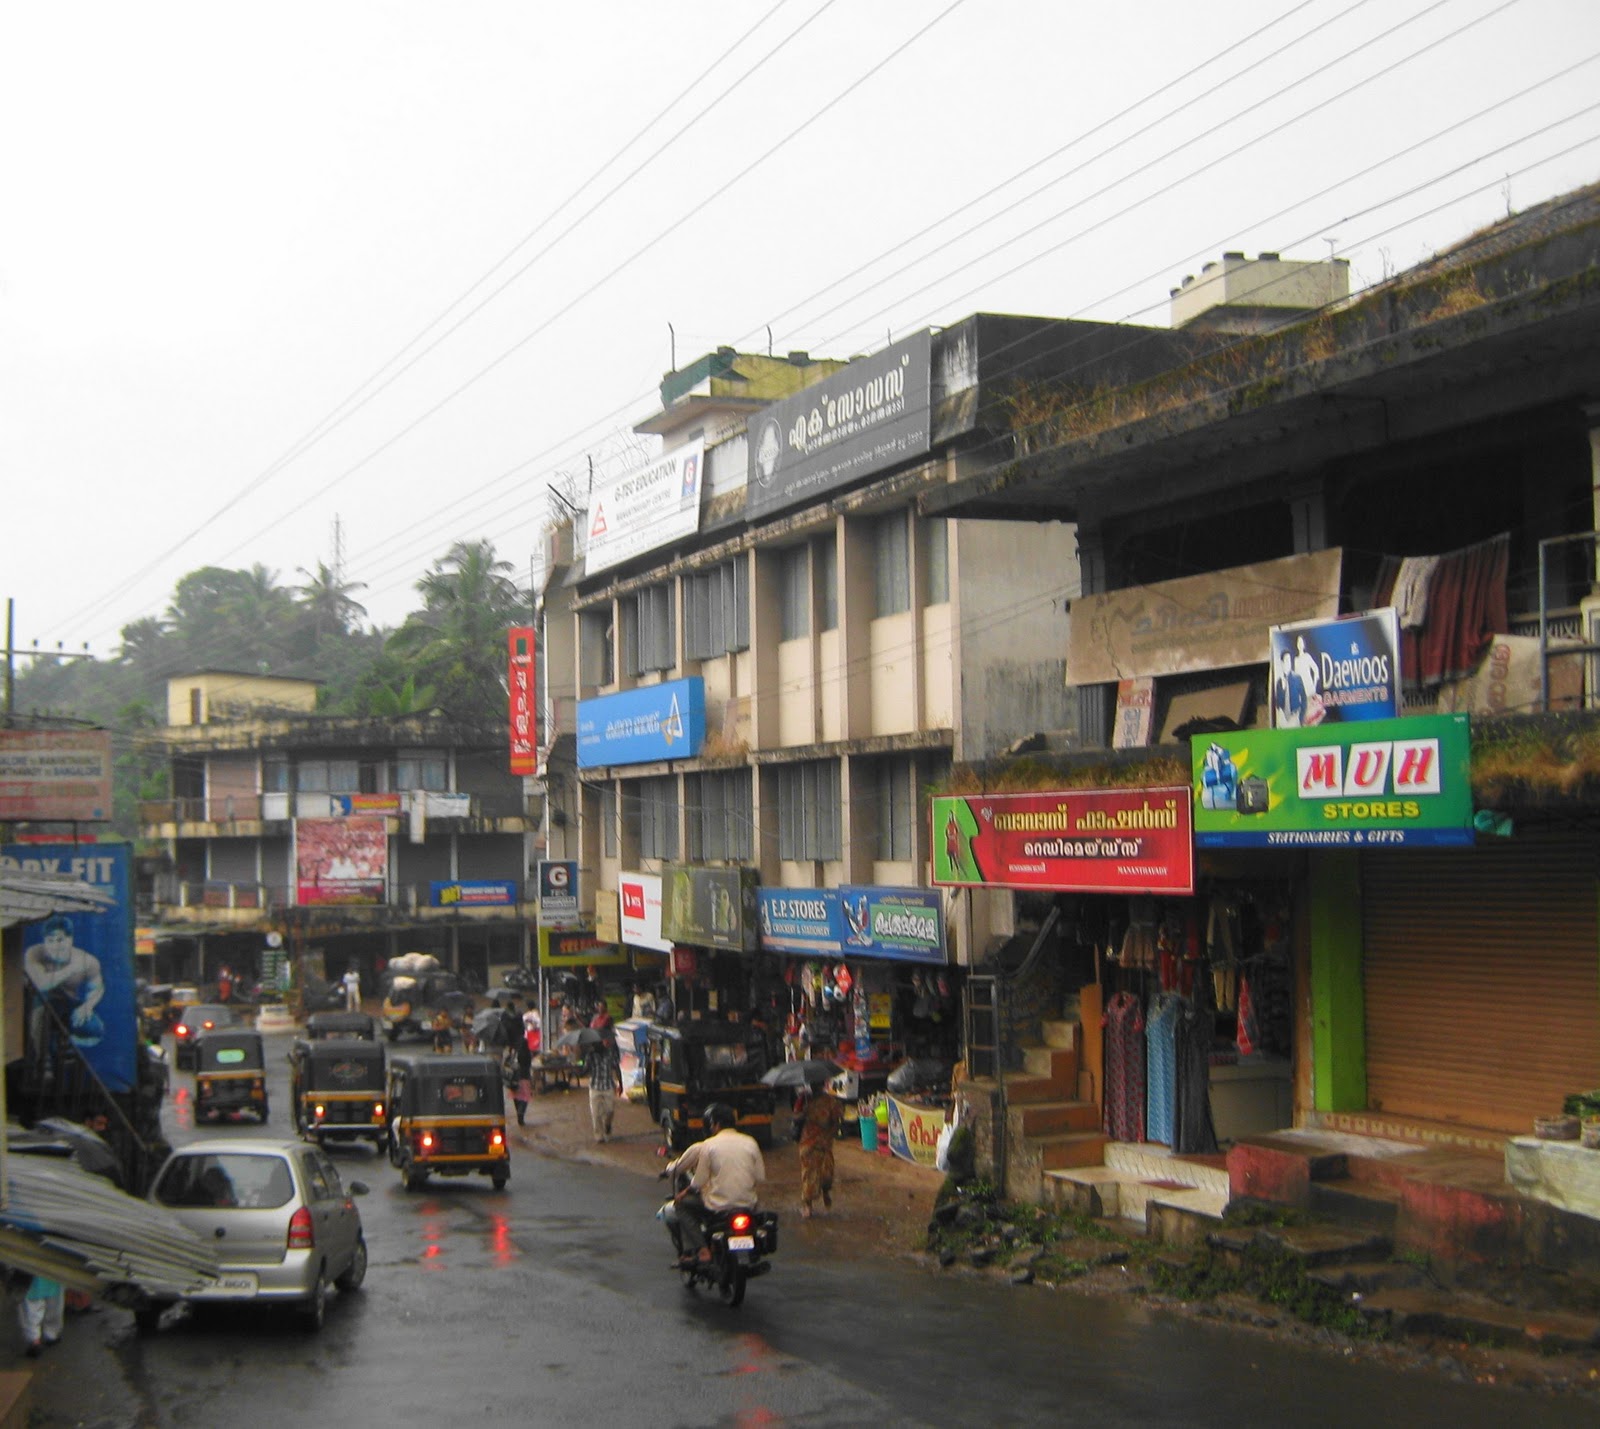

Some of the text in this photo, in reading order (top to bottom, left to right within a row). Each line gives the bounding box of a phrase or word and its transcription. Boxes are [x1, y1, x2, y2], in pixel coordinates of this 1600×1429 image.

[1321, 652, 1388, 690] Daewoos
[1323, 686, 1388, 706] GARMENTS
[1303, 747, 1432, 790] MUH
[994, 804, 1068, 832] ബാവാസ്
[1323, 801, 1420, 819] STORES
[1268, 830, 1405, 844] STATIONARIES & GIFTS
[71, 857, 115, 883] FIT
[549, 866, 568, 887] G
[771, 898, 827, 921] E.P. STORES
[773, 923, 796, 934] CROCKERY
